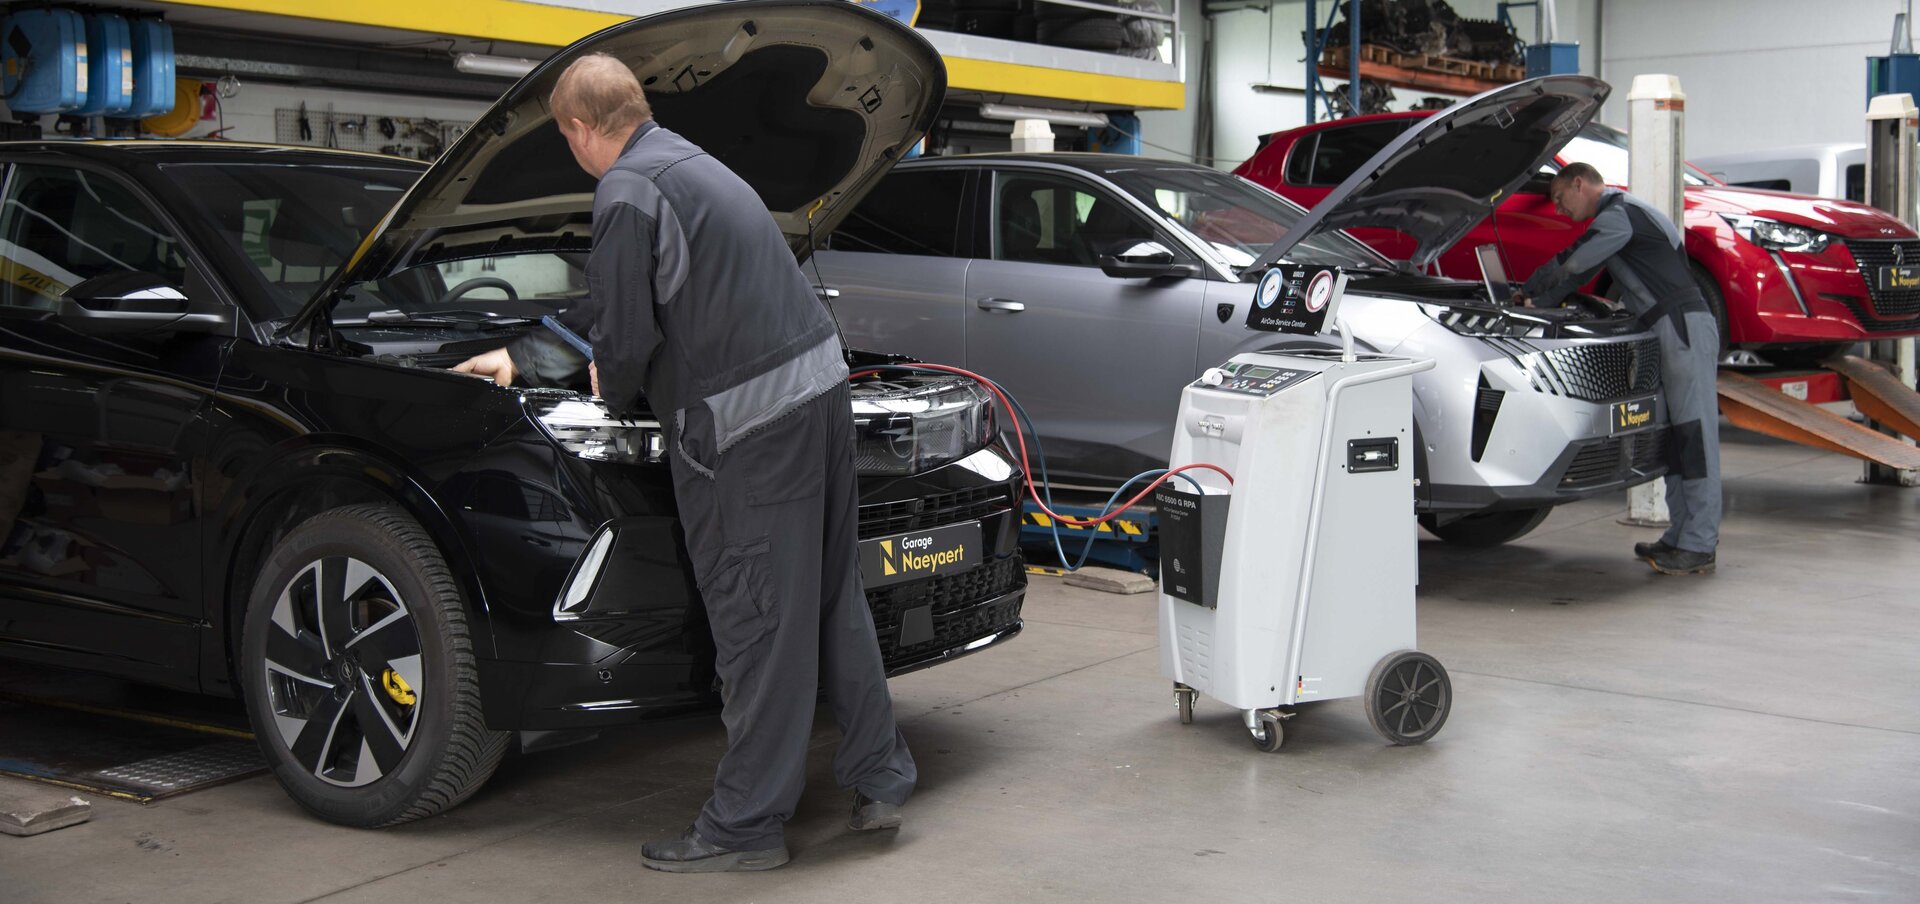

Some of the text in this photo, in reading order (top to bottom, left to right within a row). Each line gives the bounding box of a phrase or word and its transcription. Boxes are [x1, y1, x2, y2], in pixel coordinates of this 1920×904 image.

[1260, 317, 1307, 328] AirCon Service Center
[1183, 500, 1196, 509] RPA
[902, 537, 933, 549] Garage
[902, 544, 964, 573] Naeyaert
